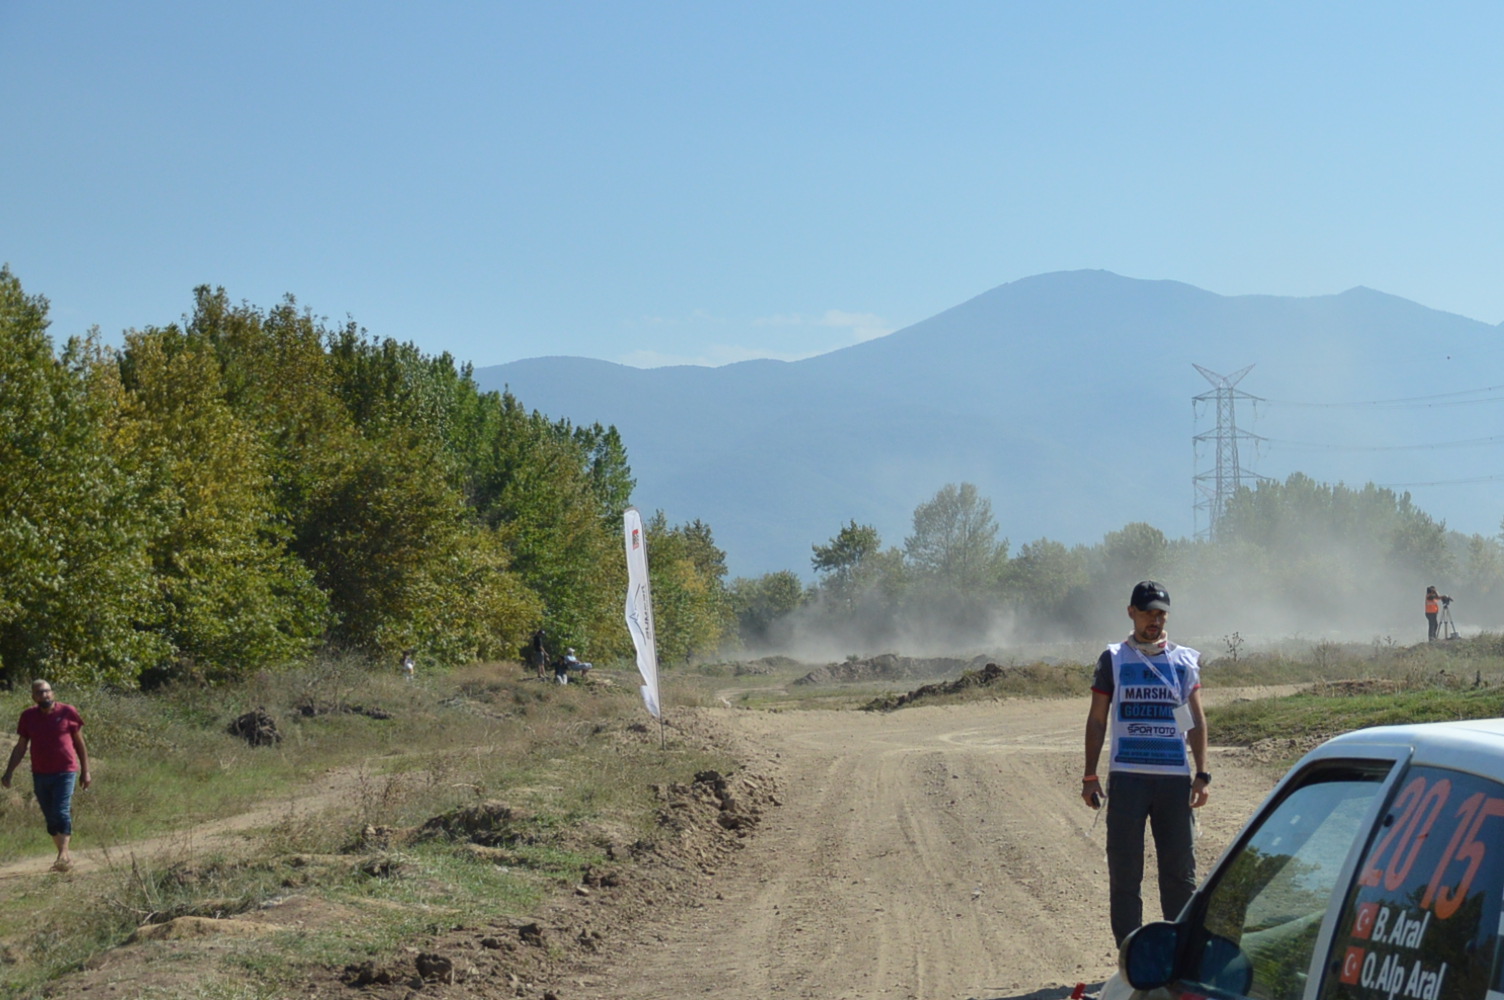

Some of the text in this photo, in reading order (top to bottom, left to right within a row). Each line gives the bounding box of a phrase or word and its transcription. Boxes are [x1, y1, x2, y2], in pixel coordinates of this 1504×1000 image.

[1125, 688, 1176, 700] MARSHA
[1125, 703, 1173, 717] GÖZETME
[1127, 726, 1176, 735] SPOR TOTO
[1358, 776, 1452, 892] 20
